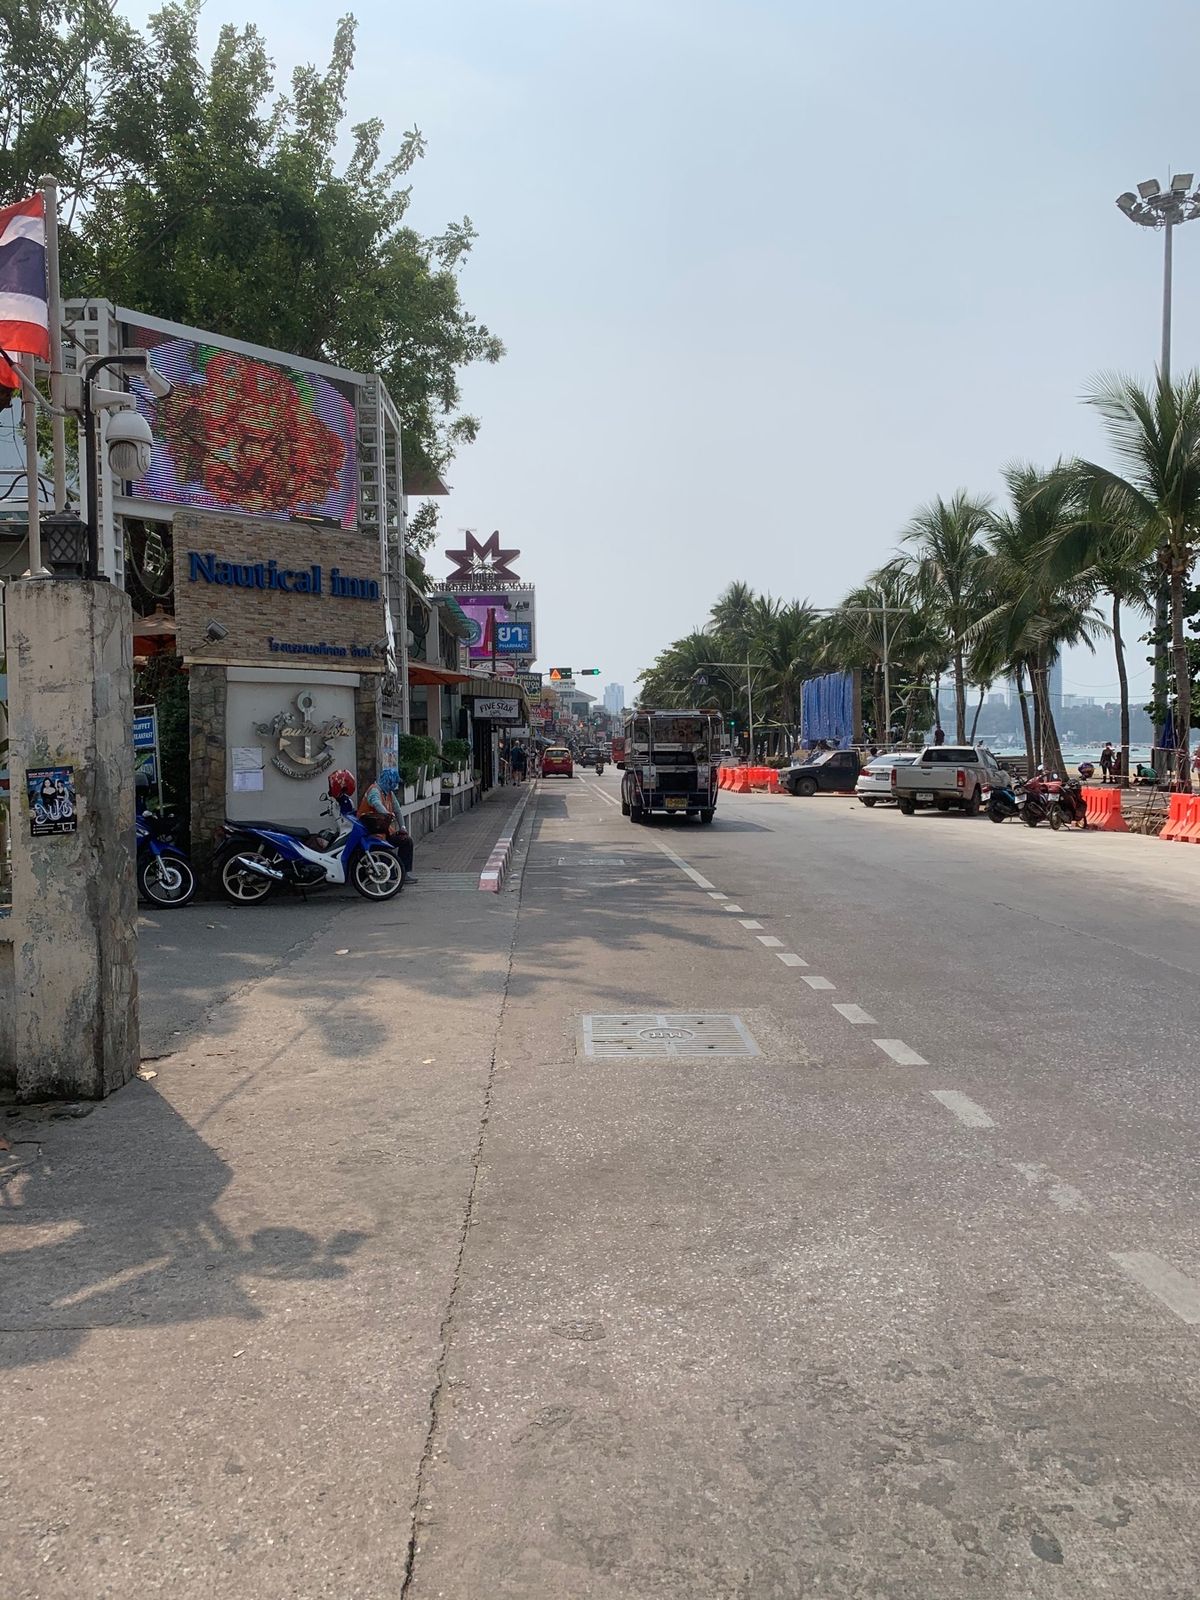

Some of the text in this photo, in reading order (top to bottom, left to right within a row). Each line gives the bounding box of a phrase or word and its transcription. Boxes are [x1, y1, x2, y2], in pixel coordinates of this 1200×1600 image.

[187, 552, 380, 601] Nautical inn
[498, 626, 523, 642] ยา
[480, 703, 496, 713] FIVE
[496, 702, 514, 713] STAR
